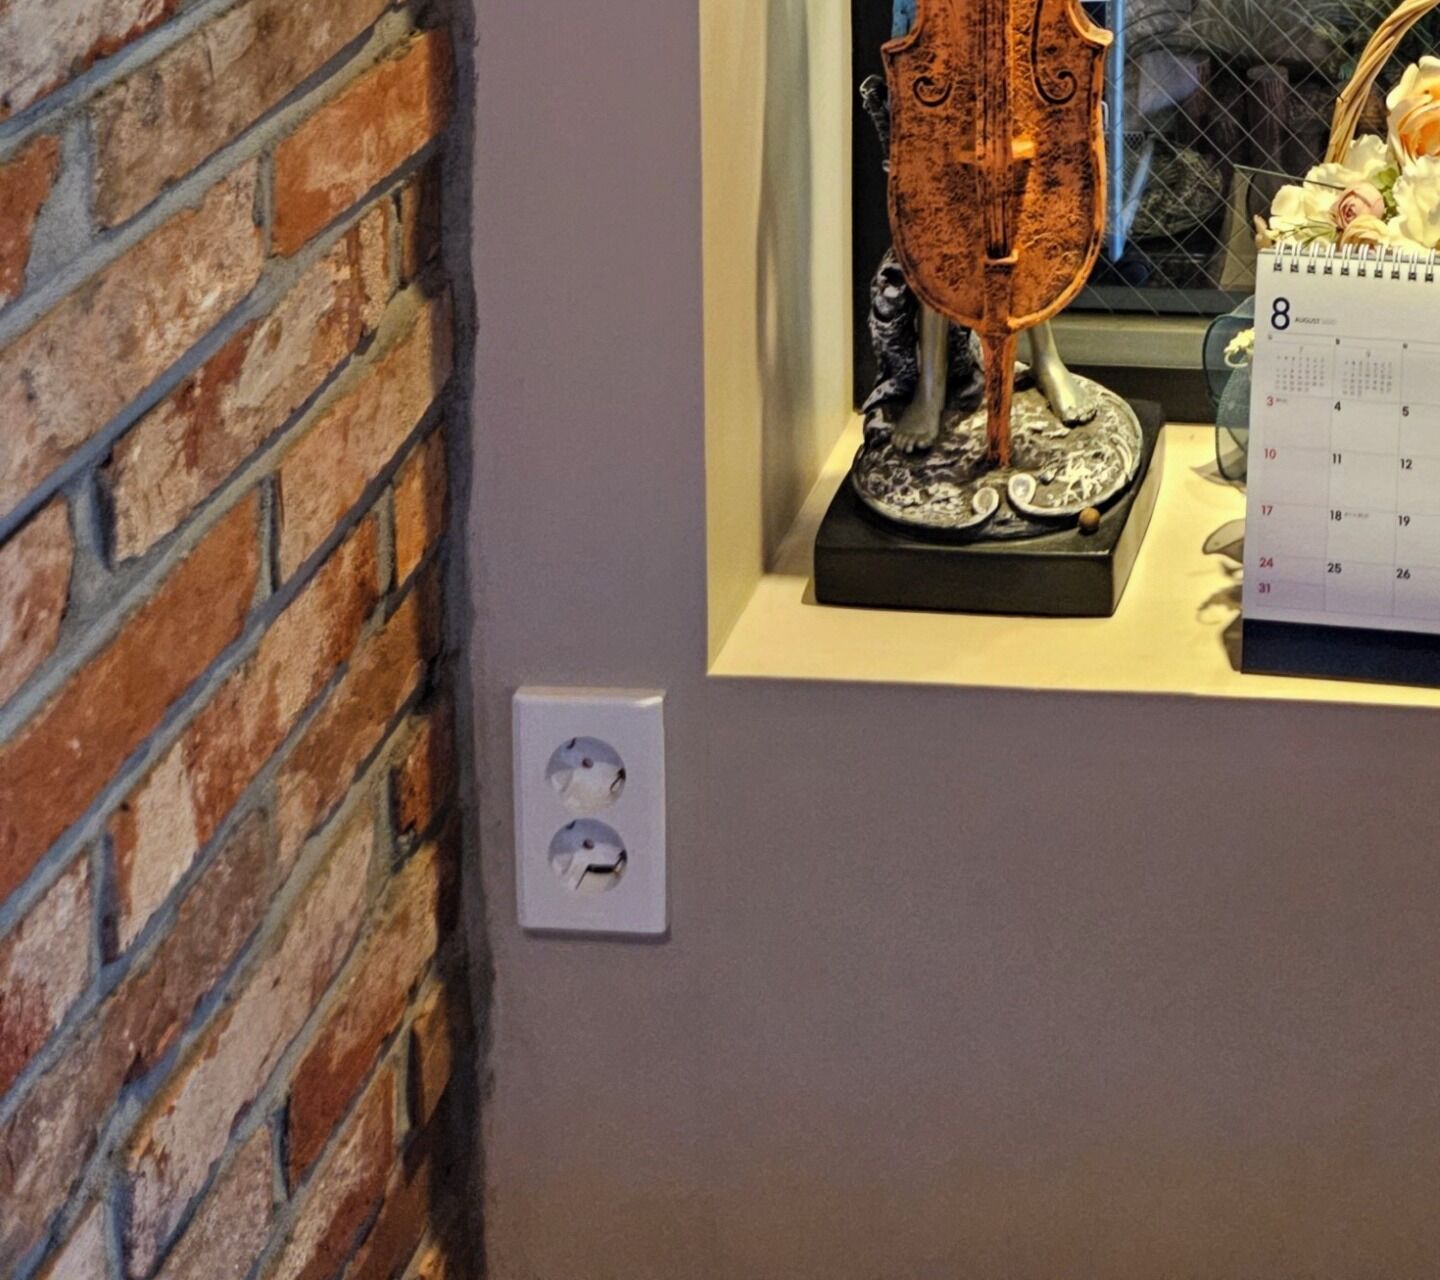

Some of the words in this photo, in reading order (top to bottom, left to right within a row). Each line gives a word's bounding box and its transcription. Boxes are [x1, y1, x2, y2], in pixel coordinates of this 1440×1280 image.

[1270, 296, 1290, 331] 8
[1266, 395, 1274, 407] 3
[1333, 401, 1342, 412] 4
[1401, 405, 1410, 418] 5
[1264, 447, 1277, 460] 10
[1332, 452, 1342, 465] 11
[1400, 458, 1413, 470] 12
[1261, 504, 1274, 516] 17
[1330, 509, 1342, 522] 18
[1398, 515, 1411, 527] 19
[1259, 556, 1274, 569] 24
[1327, 562, 1342, 574] 25
[1396, 567, 1411, 580] 26
[1258, 582, 1271, 594] 31
